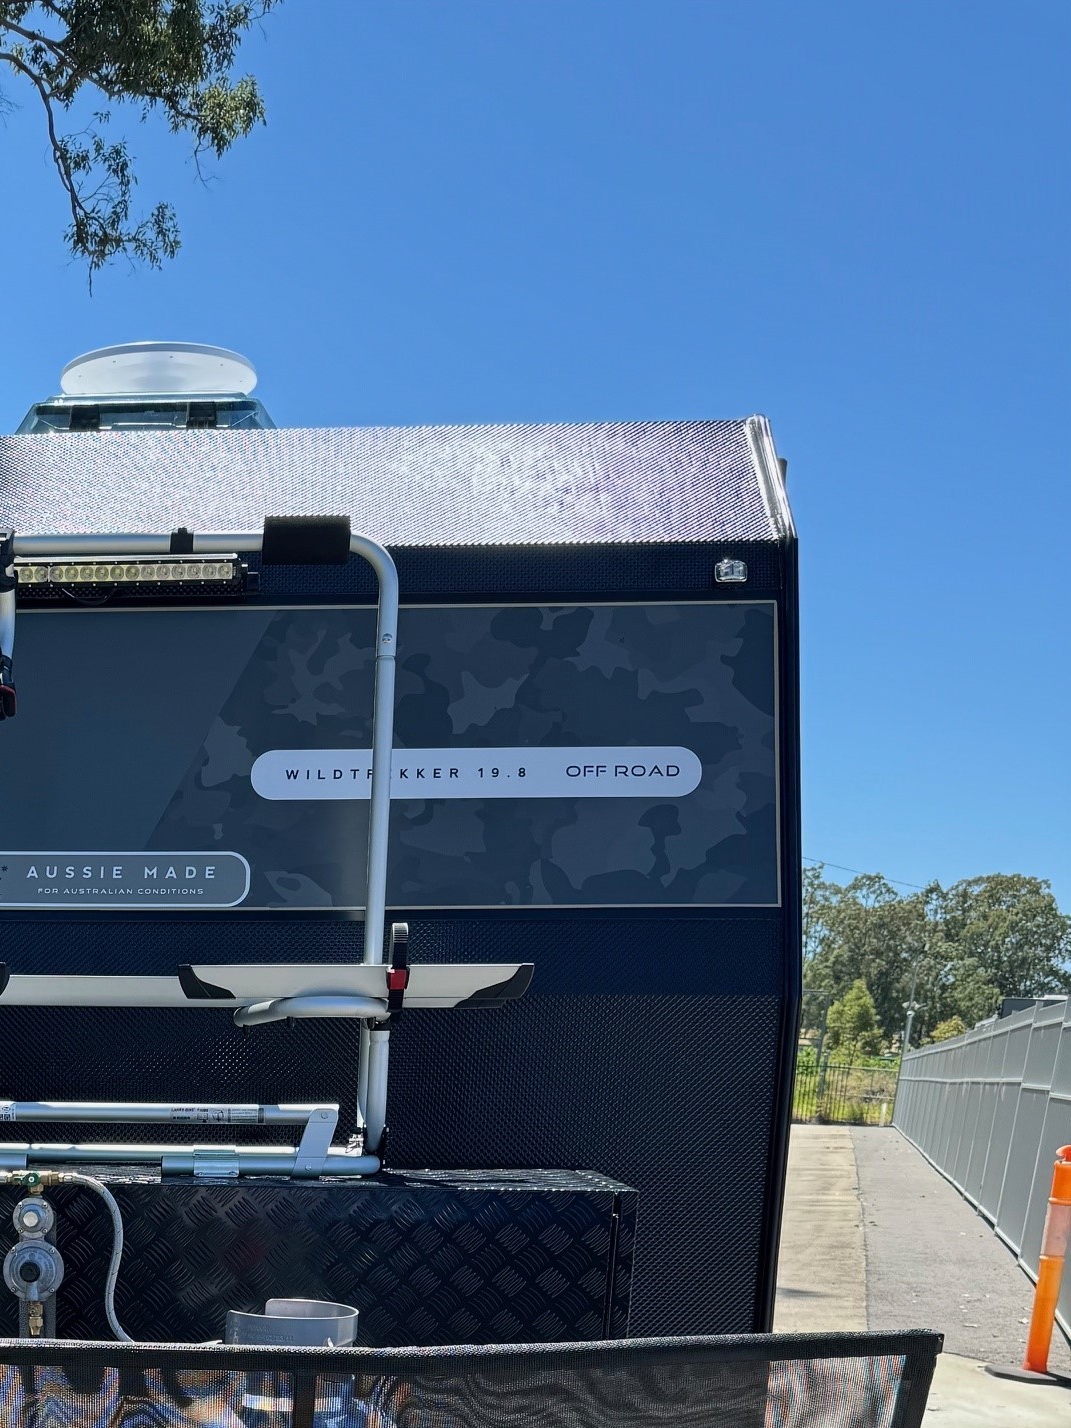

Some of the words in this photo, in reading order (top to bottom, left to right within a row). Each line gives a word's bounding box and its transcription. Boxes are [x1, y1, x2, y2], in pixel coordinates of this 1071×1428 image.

[285, 767, 460, 780] WILDTRKKER
[477, 766, 527, 778] 19.8
[565, 765, 608, 778] OFF
[613, 764, 681, 777] ROAD
[26, 865, 124, 880] AUSSIE
[143, 866, 217, 880] MADE
[37, 887, 60, 895] FOR
[63, 888, 134, 896] AUSTRALIAN
[137, 888, 205, 896] CONDITIONS
